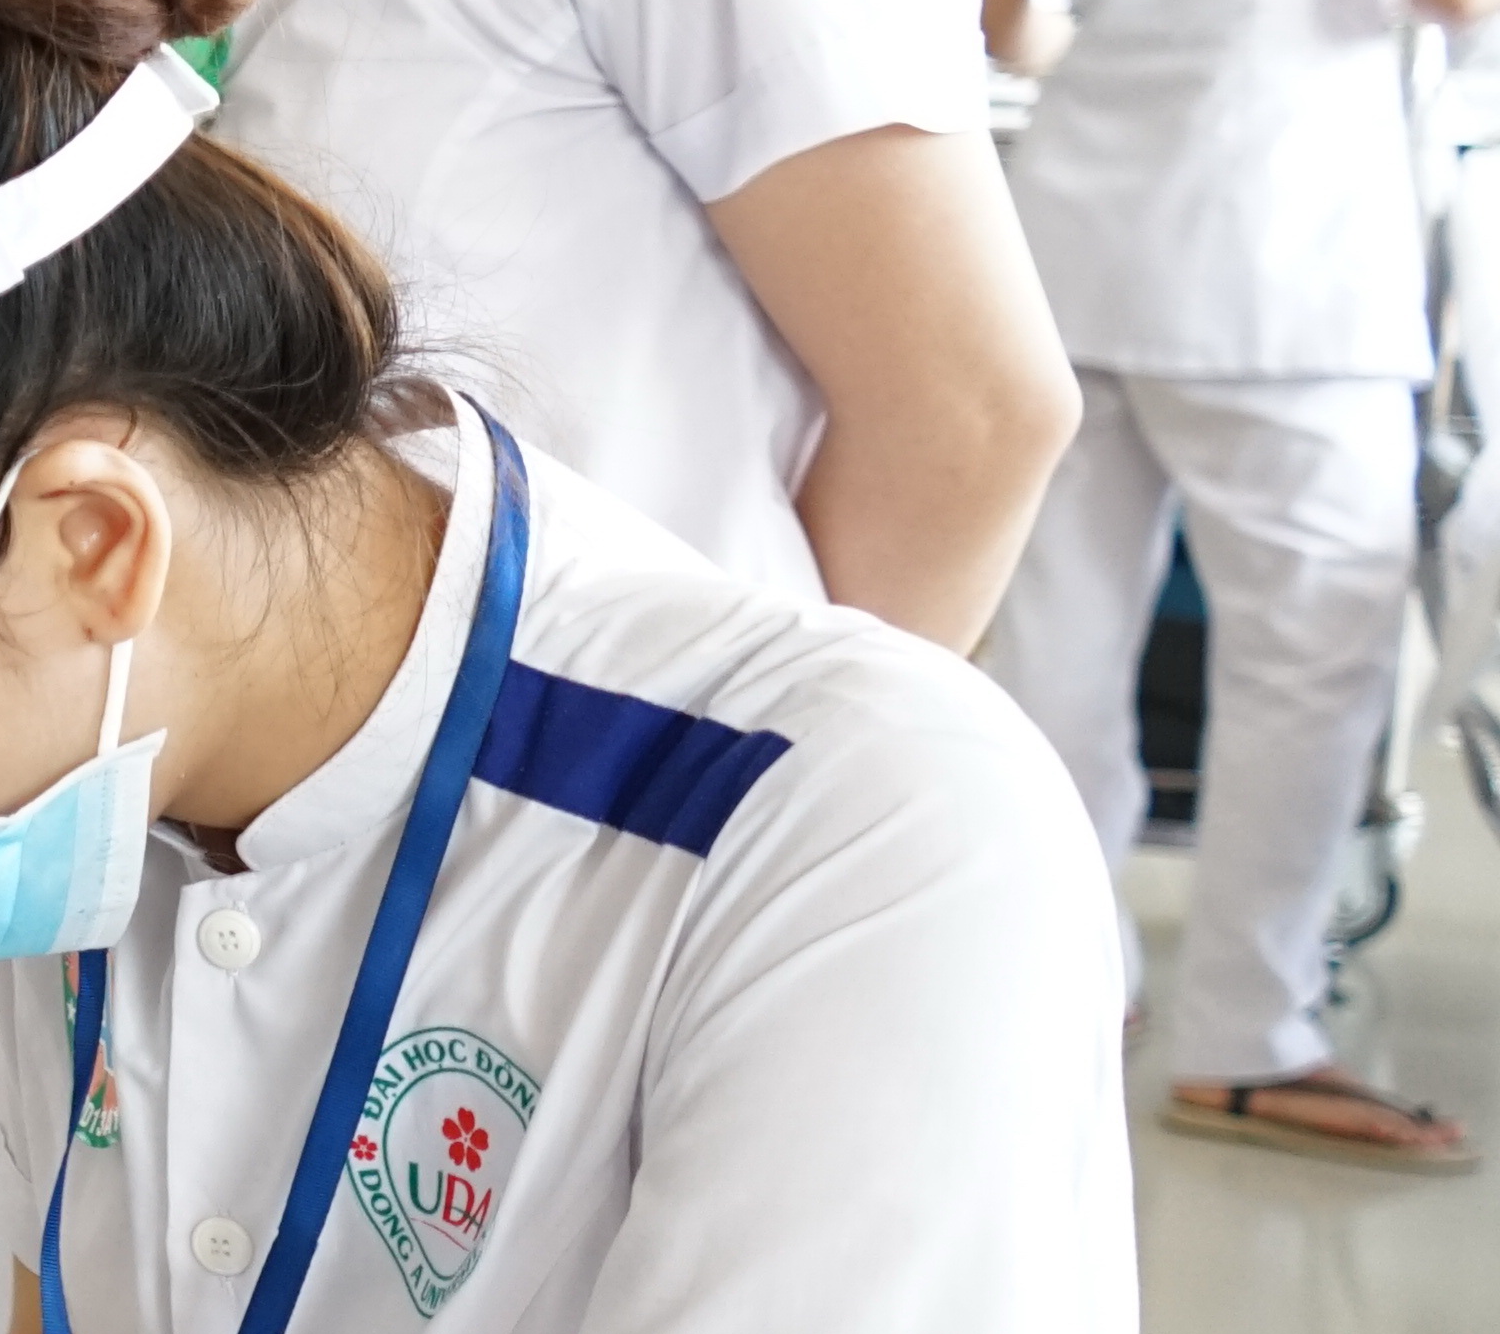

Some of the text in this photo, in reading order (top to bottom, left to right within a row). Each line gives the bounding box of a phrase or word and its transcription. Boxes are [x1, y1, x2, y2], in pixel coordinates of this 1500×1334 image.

[362, 1065, 405, 1121] ĐẠI
[401, 1039, 468, 1074] HỌC
[357, 1169, 414, 1261] DONG
[410, 1264, 424, 1290] A
[408, 1161, 493, 1242] UDA
